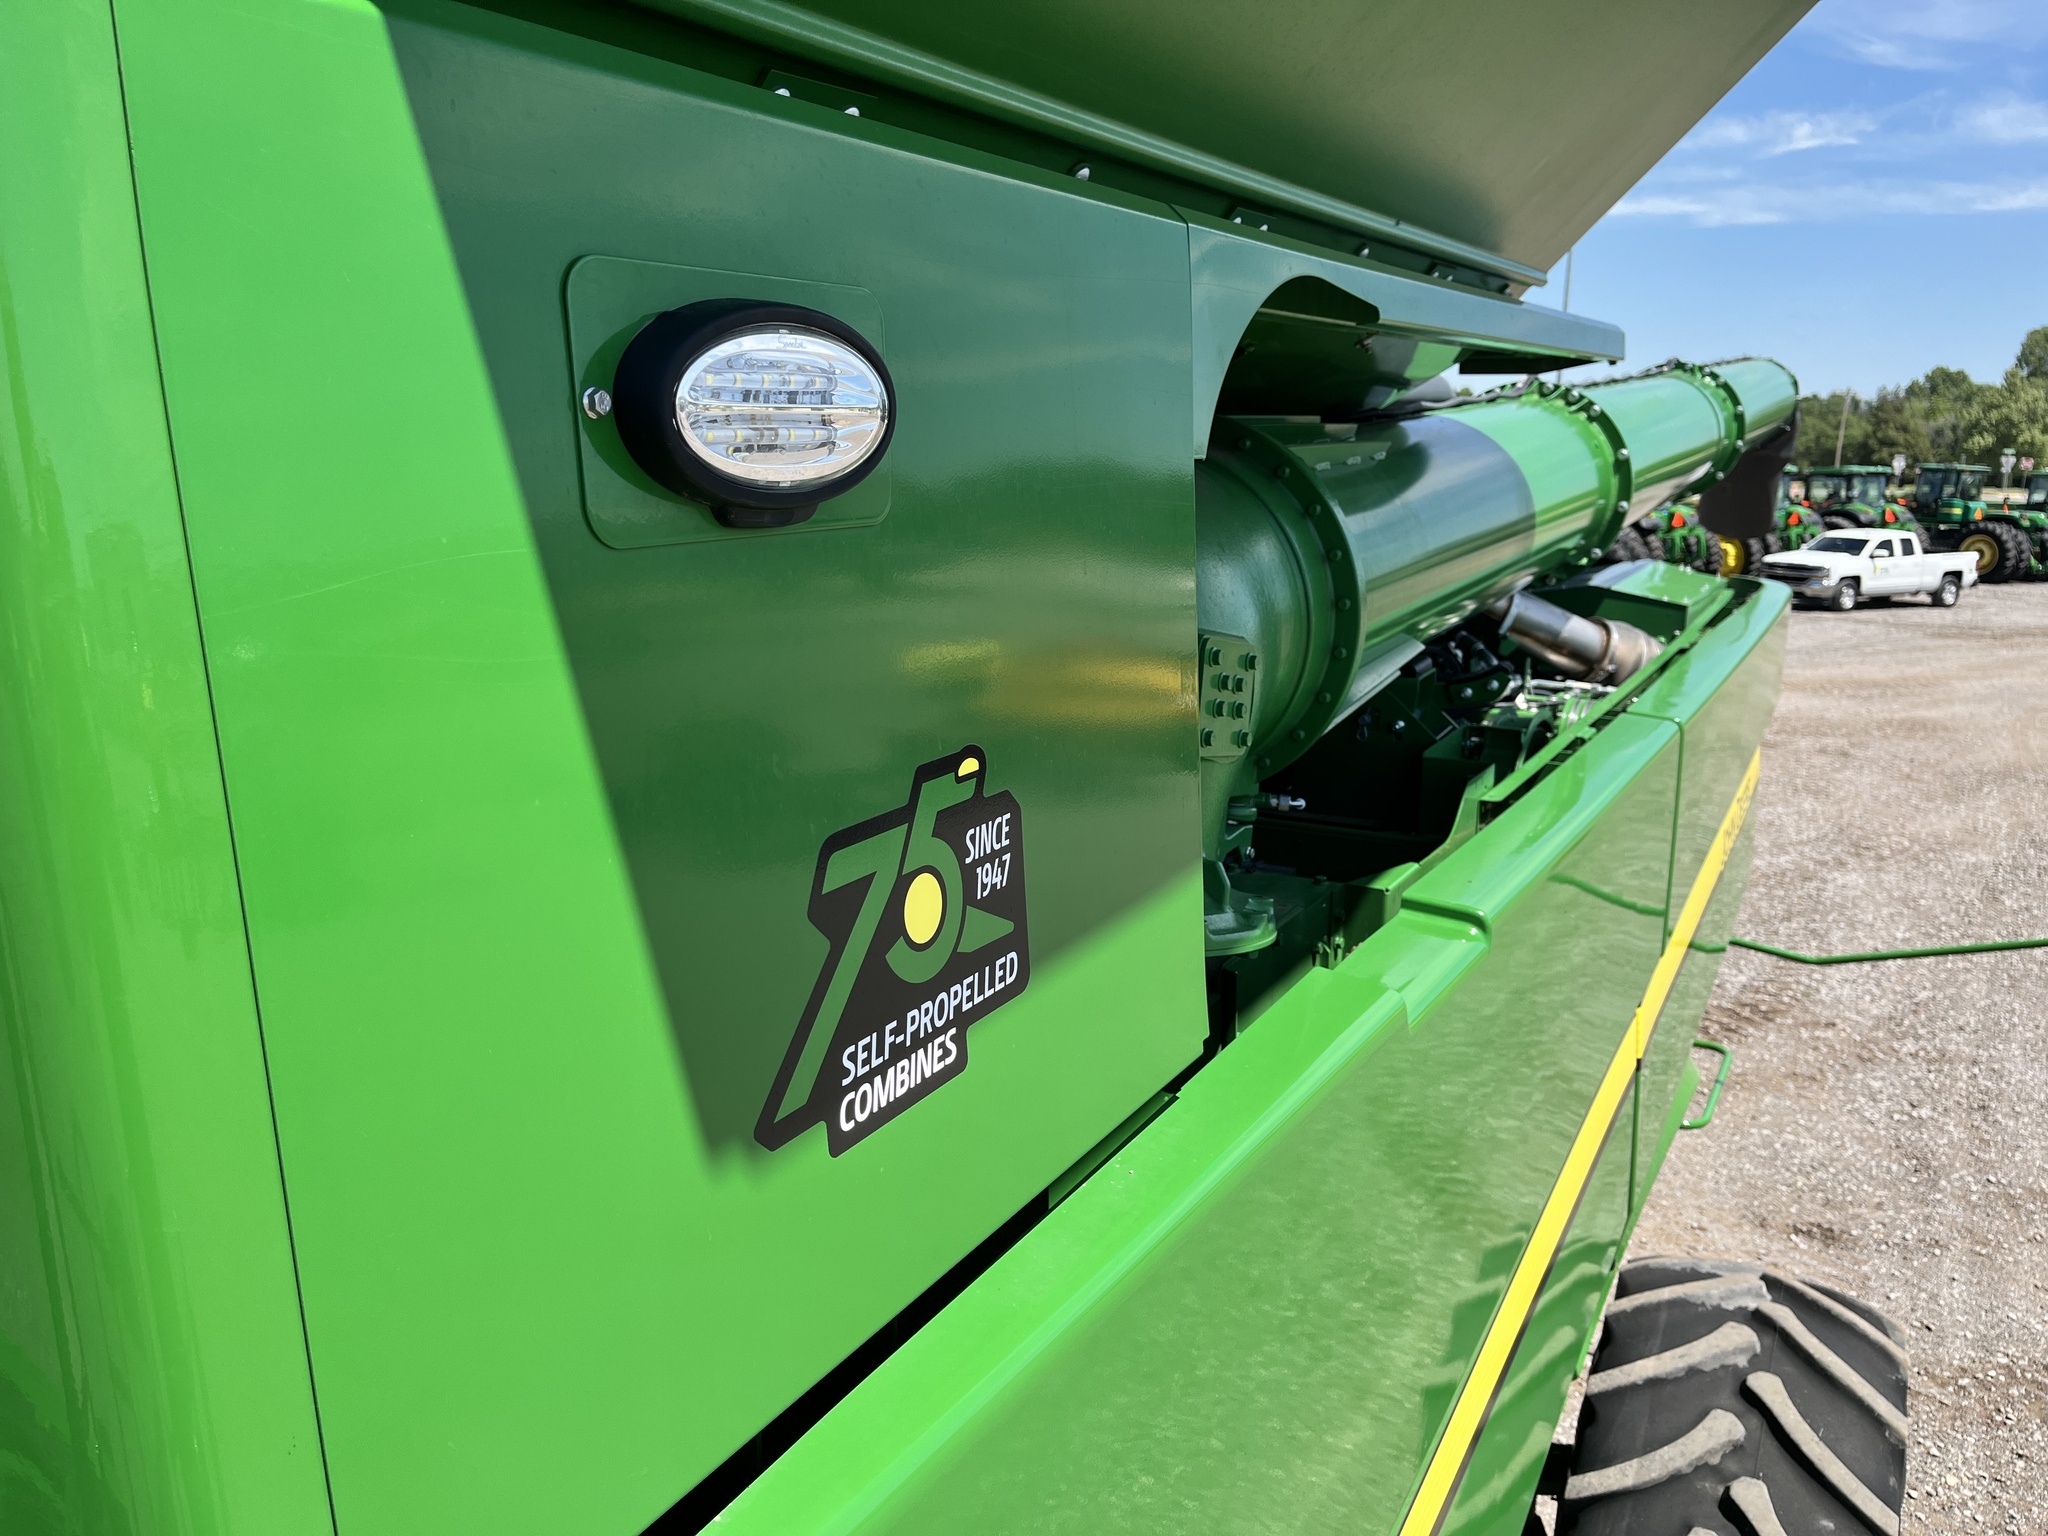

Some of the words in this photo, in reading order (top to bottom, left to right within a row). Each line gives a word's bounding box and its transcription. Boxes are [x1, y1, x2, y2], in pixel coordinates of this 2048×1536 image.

[965, 813, 1011, 864] SINCE
[976, 853, 1011, 900] 1947
[842, 952, 1018, 1086] SELF-PROPELLED
[839, 1027, 958, 1132] COMBINES
